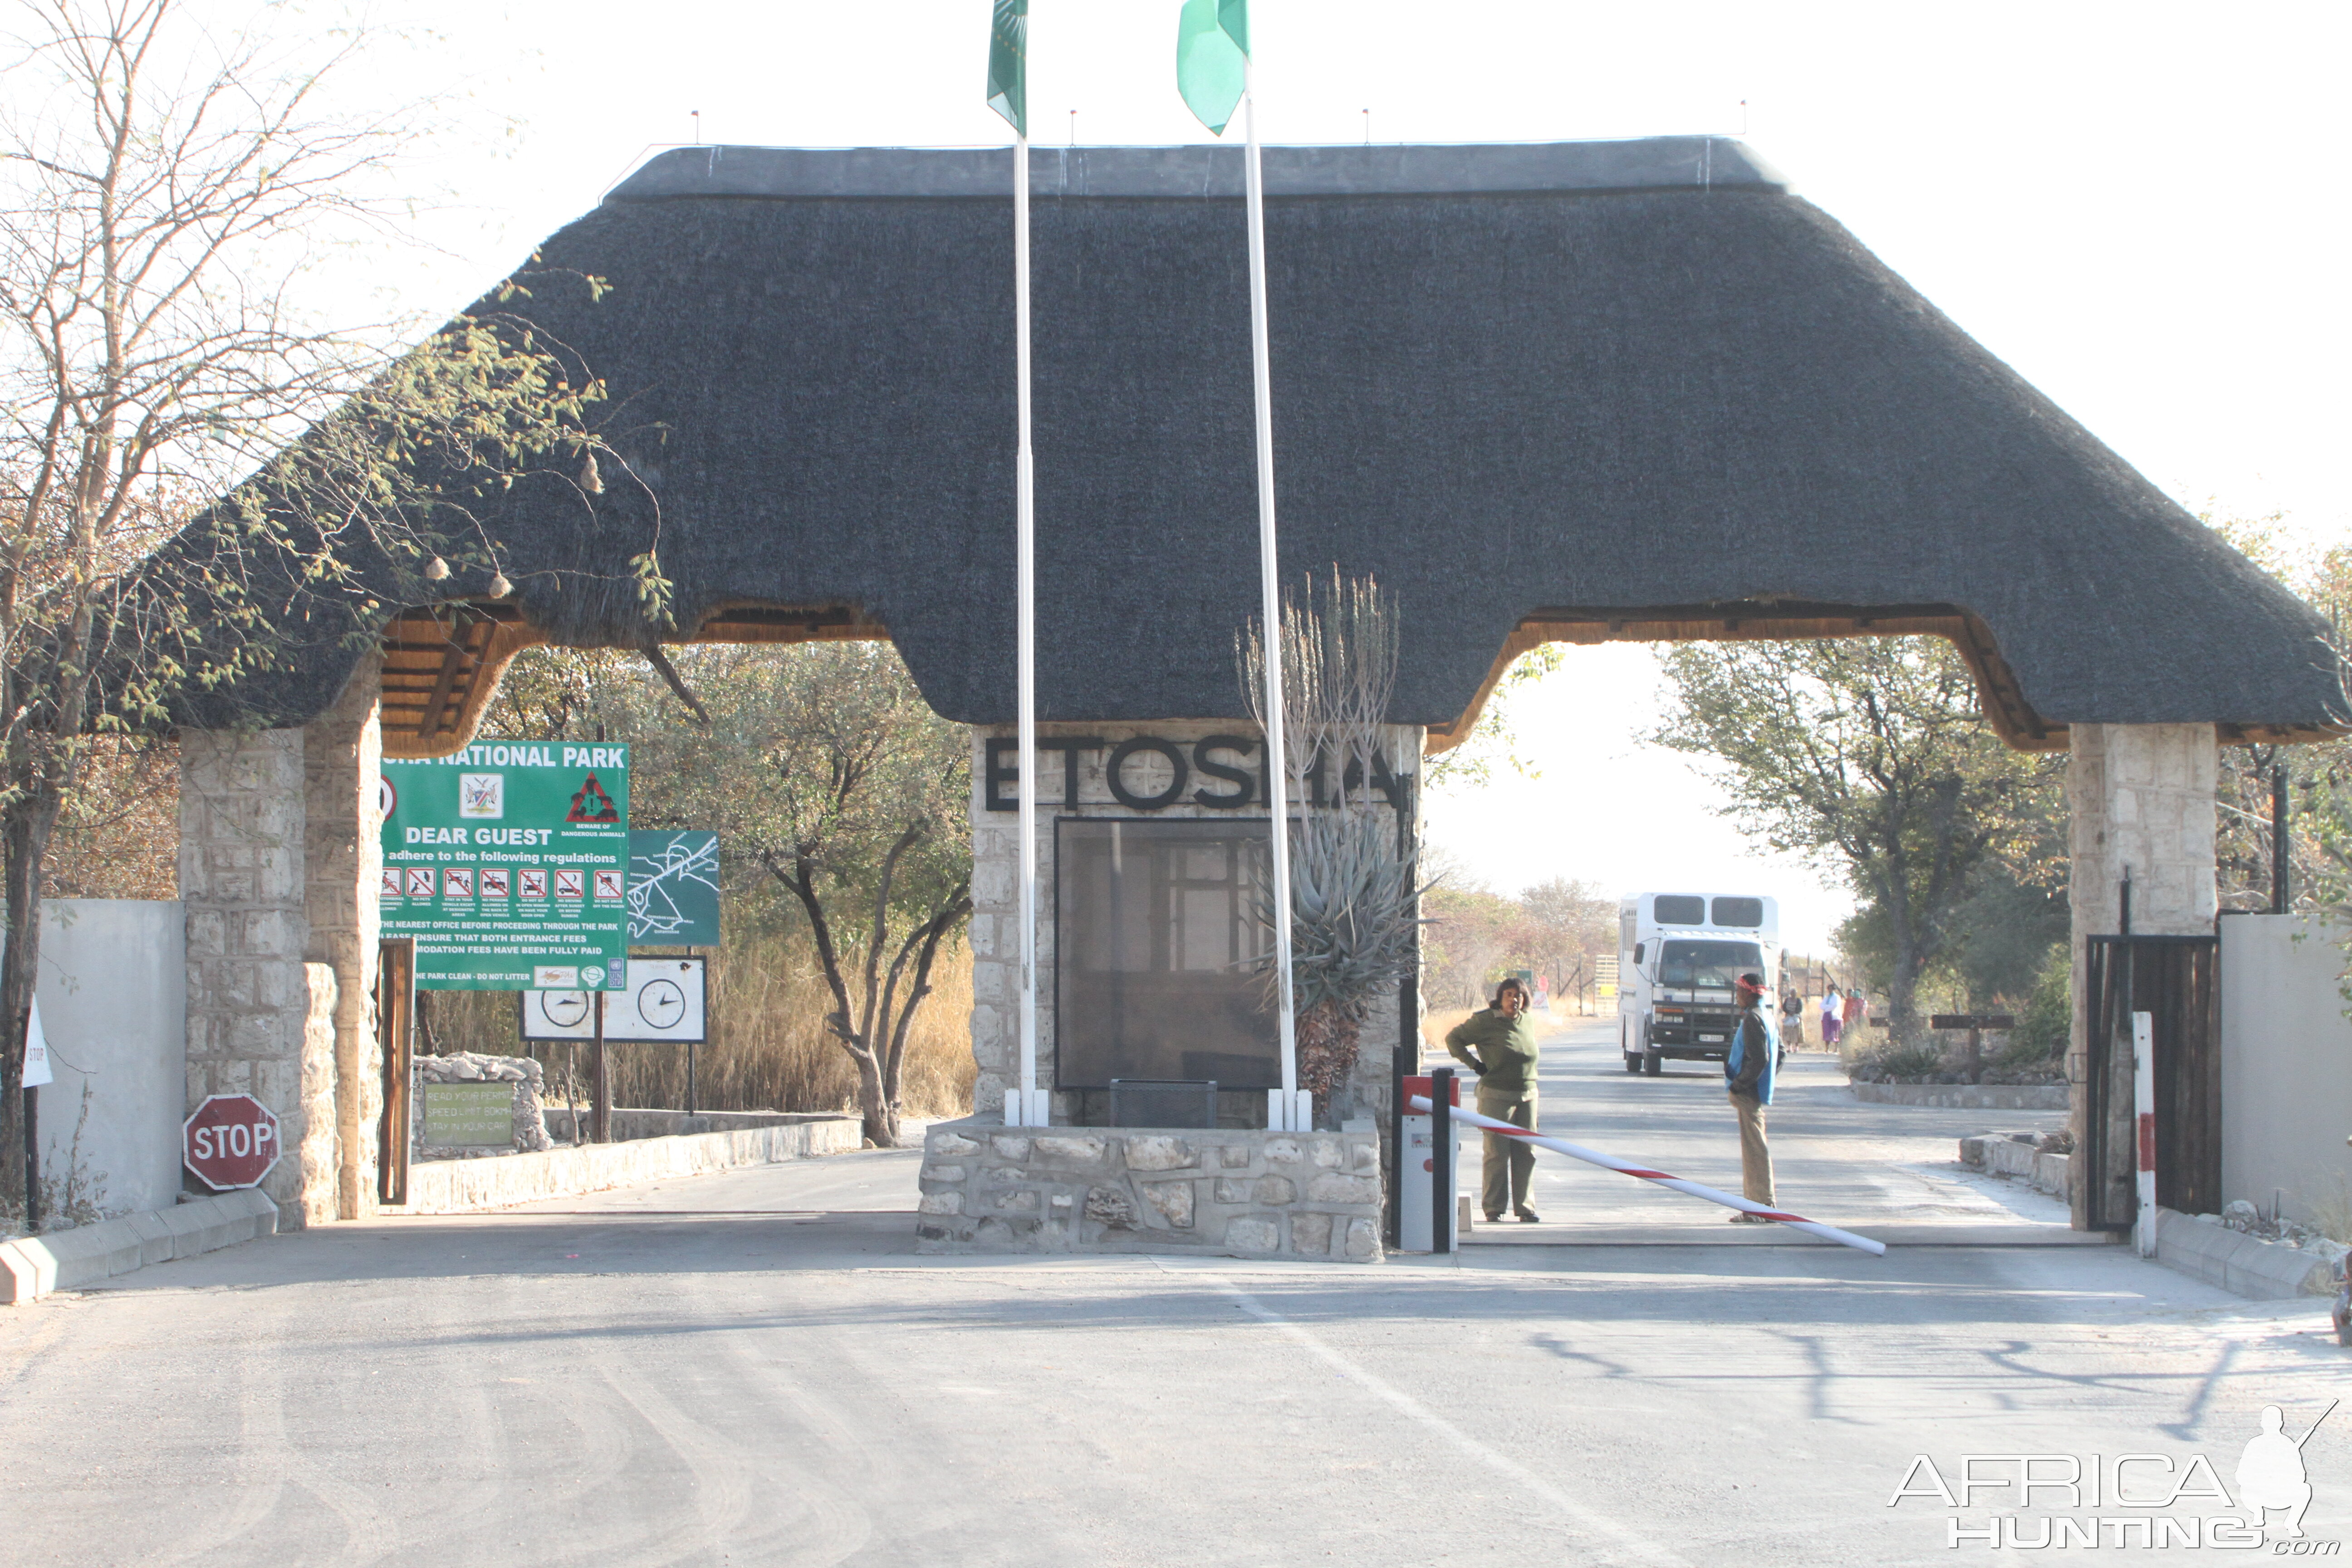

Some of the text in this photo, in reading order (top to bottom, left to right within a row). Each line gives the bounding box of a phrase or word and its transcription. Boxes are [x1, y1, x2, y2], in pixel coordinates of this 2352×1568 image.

[563, 747, 625, 768] PARK
[985, 735, 1397, 811] ETOSHA
[406, 827, 552, 845] DEAR GUEST
[389, 850, 434, 860] adhere
[438, 851, 451, 861] to
[455, 851, 477, 861] the
[480, 851, 539, 864] following
[544, 853, 617, 864] regulations
[29, 1047, 44, 1061] STOP
[427, 1090, 511, 1101] READ YOUR PERMIT
[427, 1107, 457, 1117] SPEED
[459, 1106, 482, 1116] LIMIT
[427, 1122, 450, 1132] STAY
[462, 1122, 486, 1131] YOUR
[487, 1122, 506, 1131] CAR
[194, 1123, 273, 1160] STOP
